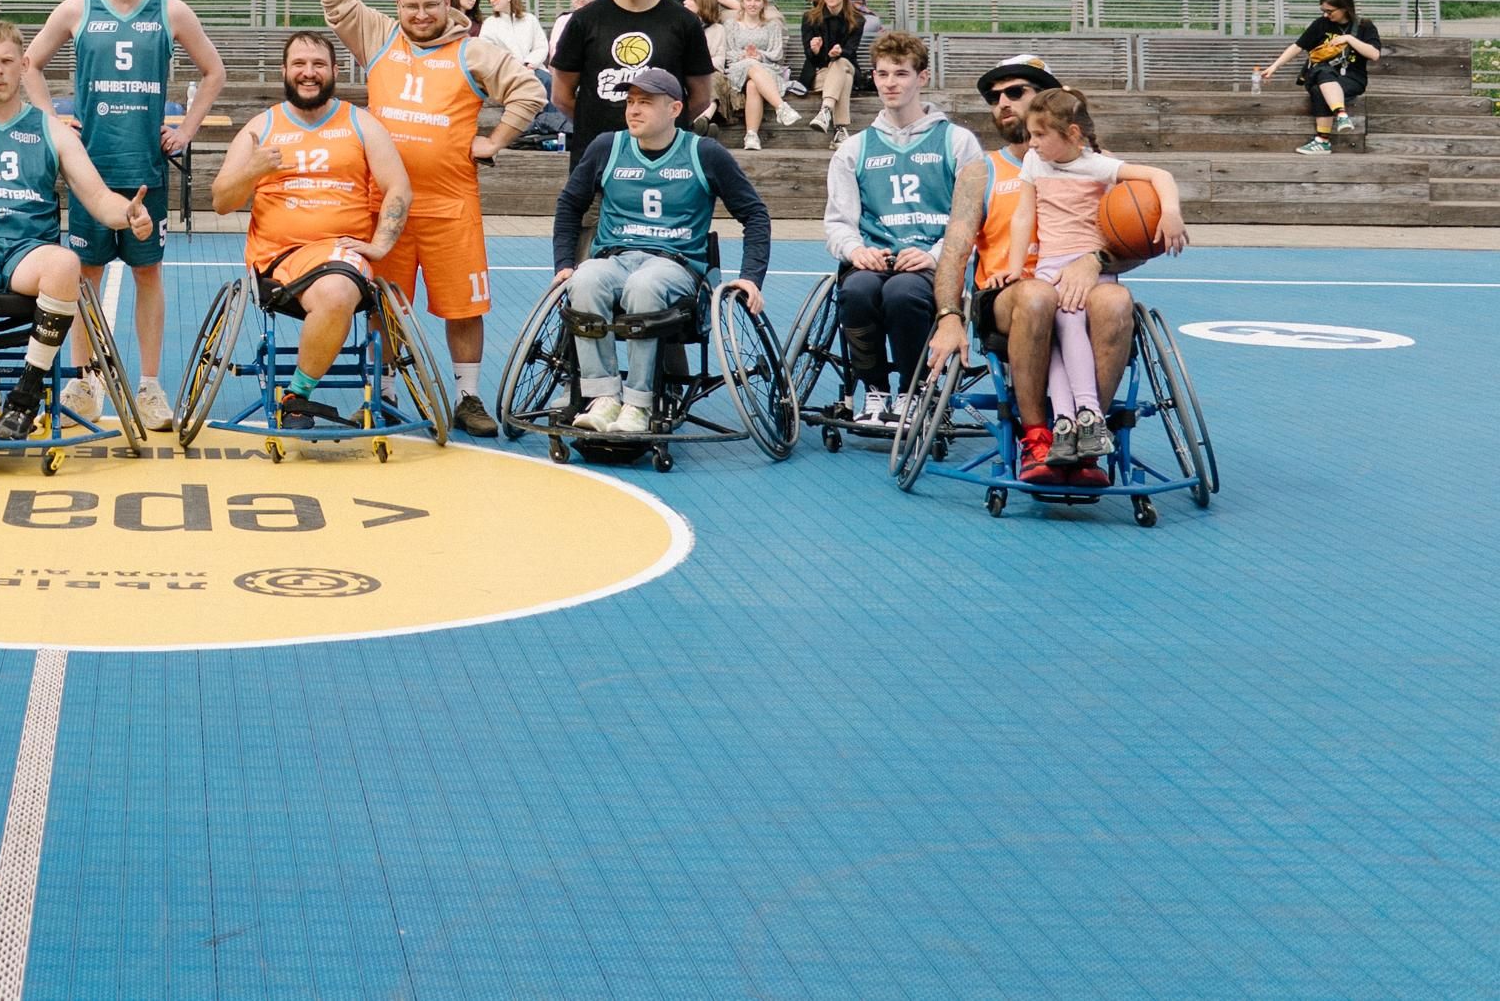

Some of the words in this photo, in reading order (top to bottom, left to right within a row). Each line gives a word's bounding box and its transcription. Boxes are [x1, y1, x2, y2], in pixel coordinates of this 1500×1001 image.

[90, 22, 116, 31] ГАРТ
[115, 41, 133, 71] 5
[399, 73, 424, 104] 11
[295, 148, 330, 174] 12
[616, 169, 643, 178] ГАРТ
[867, 155, 894, 168] ГАРТ
[643, 189, 662, 218] 6
[889, 174, 921, 205] 12
[469, 271, 491, 303] 11
